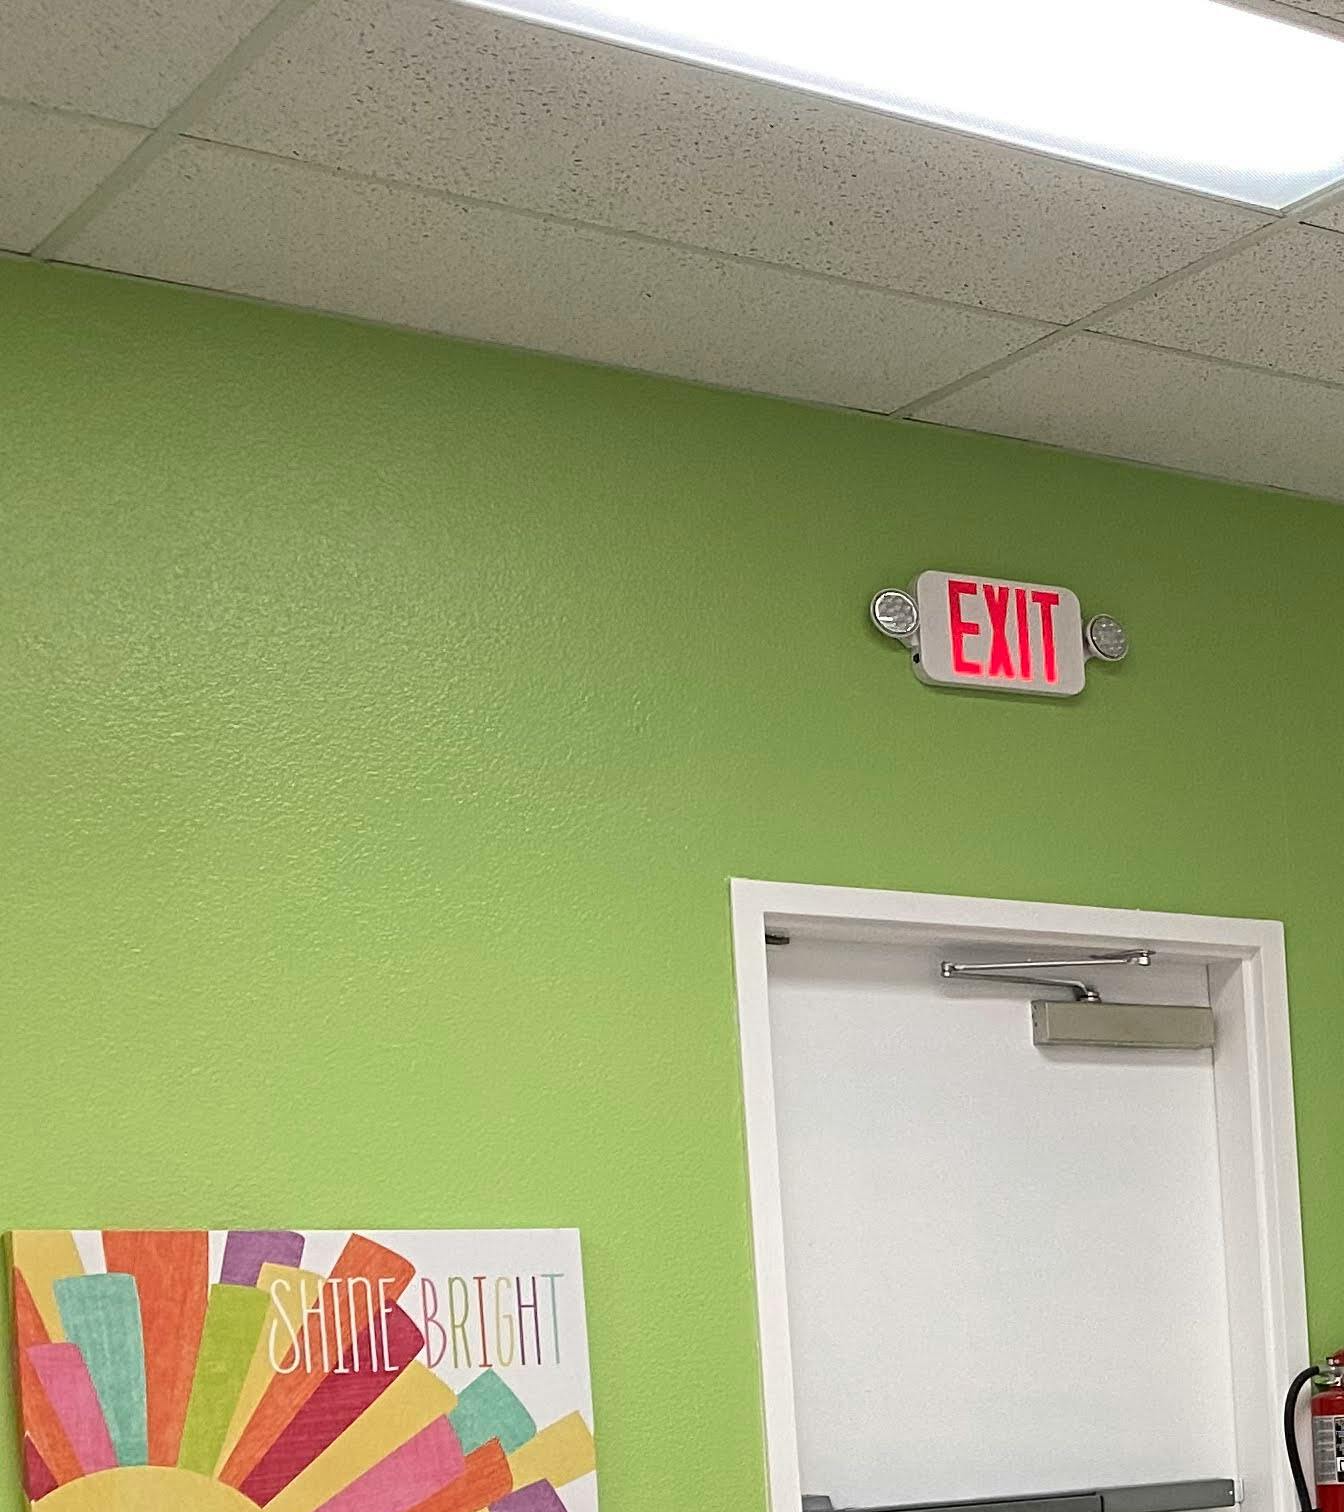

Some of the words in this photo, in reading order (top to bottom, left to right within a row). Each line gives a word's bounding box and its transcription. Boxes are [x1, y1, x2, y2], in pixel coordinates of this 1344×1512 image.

[947, 579, 1060, 685] EXIT
[269, 1276, 400, 1375] SHINE
[421, 1273, 565, 1370] BRIGHT
